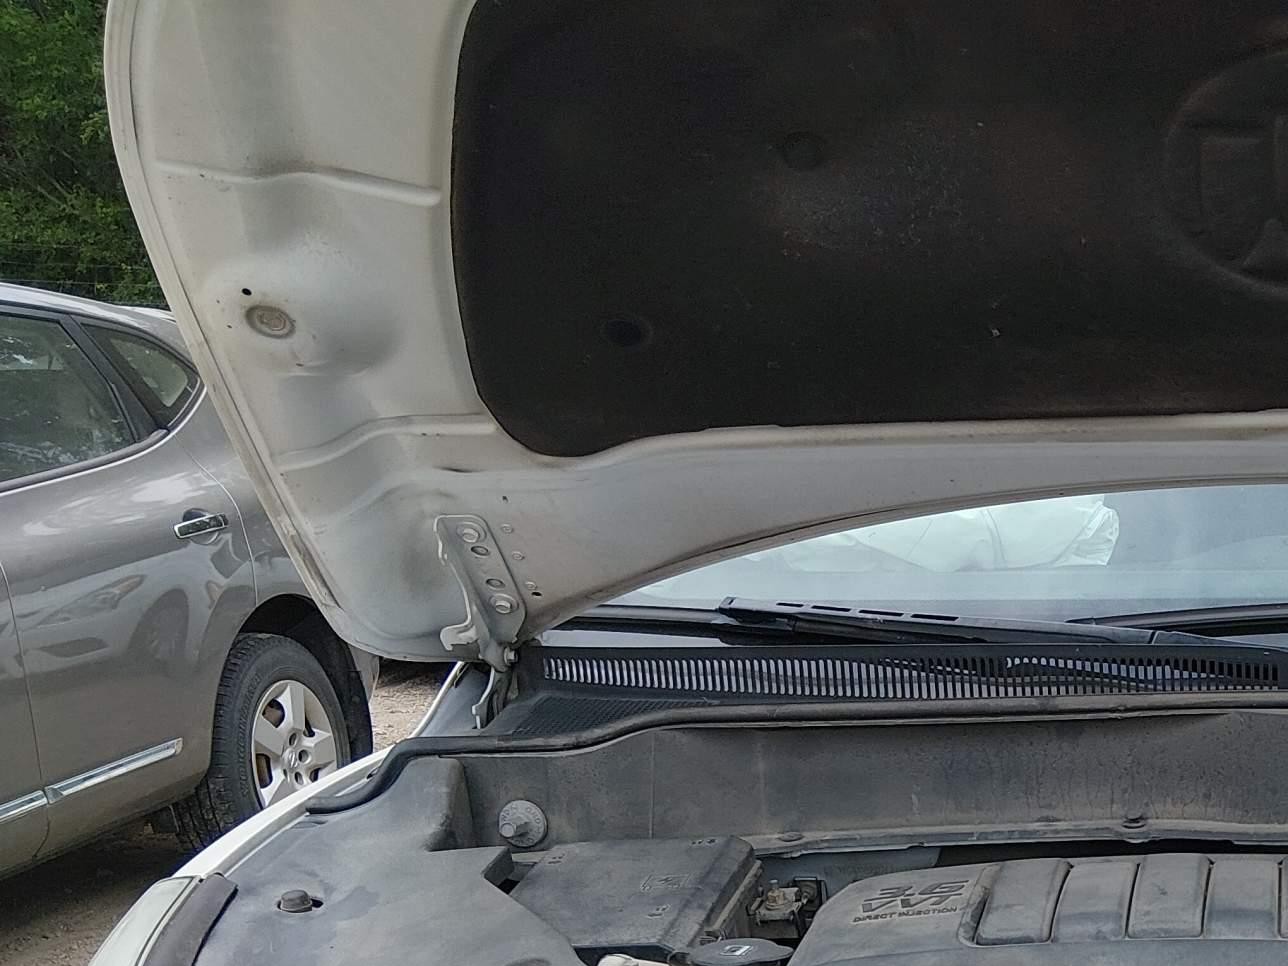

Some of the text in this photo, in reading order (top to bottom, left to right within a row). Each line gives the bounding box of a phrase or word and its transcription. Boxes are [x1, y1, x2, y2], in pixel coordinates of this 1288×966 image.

[863, 880, 969, 902] 3.6
[862, 893, 963, 913] VVT
[852, 906, 957, 923] DIRECT INJECTION
